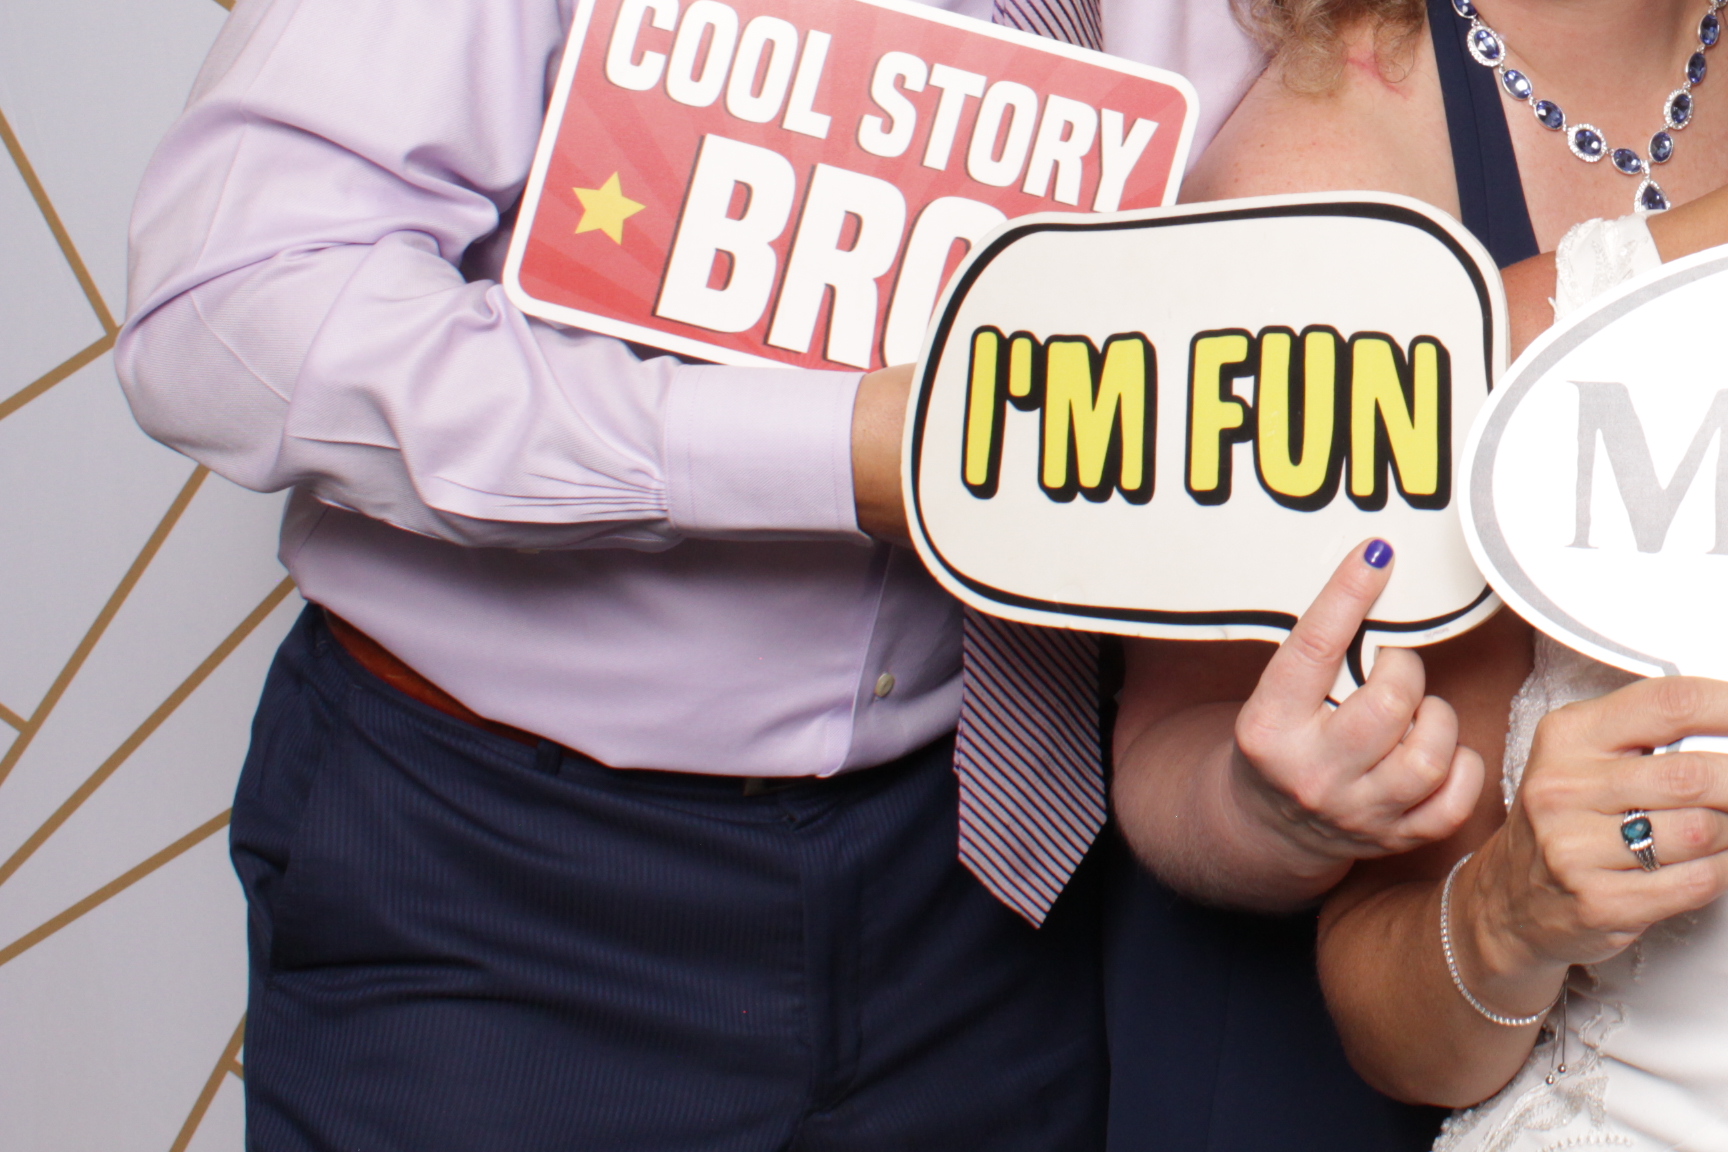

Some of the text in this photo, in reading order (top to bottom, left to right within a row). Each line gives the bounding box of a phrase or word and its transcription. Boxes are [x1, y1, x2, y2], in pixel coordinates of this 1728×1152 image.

[857, 51, 1160, 214] STORY
[962, 324, 1451, 512] I'M FUN
